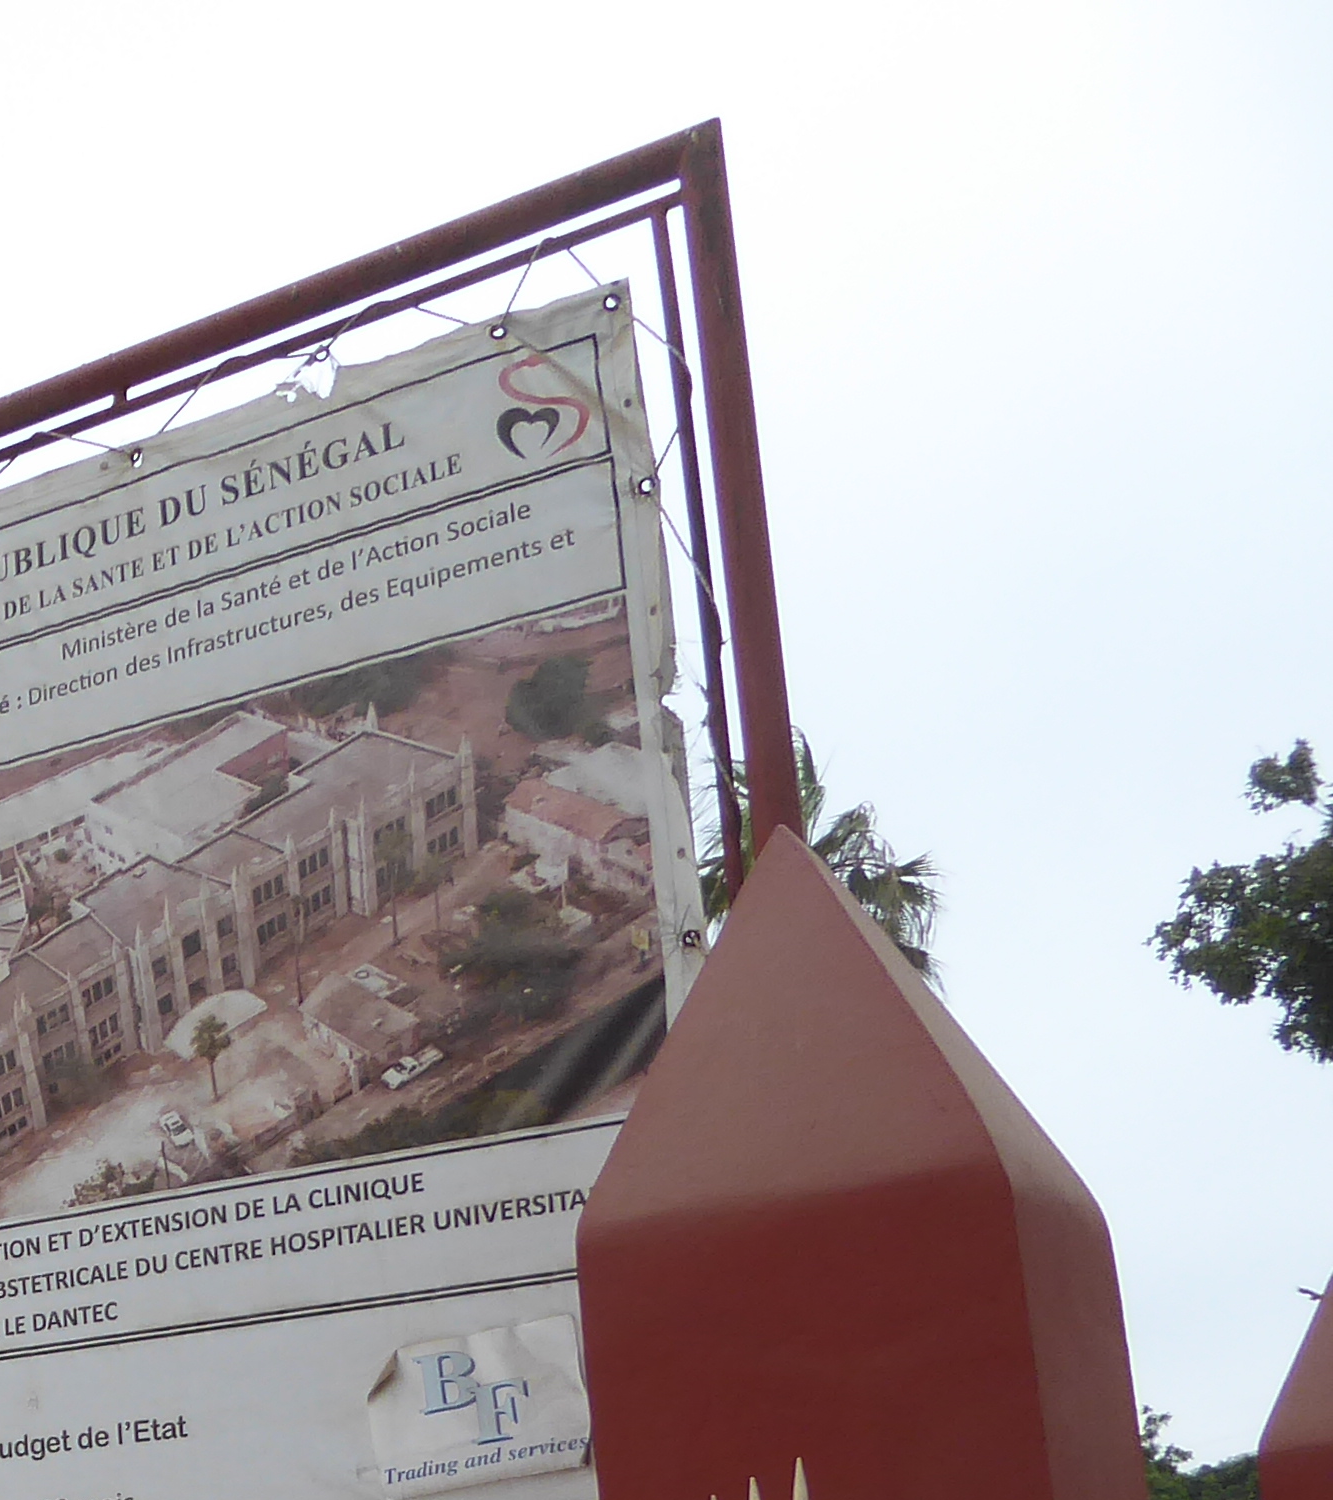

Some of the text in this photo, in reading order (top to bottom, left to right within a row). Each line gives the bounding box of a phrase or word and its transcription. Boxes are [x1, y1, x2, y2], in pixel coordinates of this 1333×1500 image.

[158, 484, 207, 528] DU
[220, 421, 406, 506] SÉNÉGAL
[3, 594, 32, 621] DE
[39, 584, 67, 609] LA
[72, 556, 145, 599] SANTE
[152, 545, 181, 572] ET
[188, 532, 219, 561] DE
[226, 491, 341, 548] L’ACTION
[349, 452, 463, 508] SOCIALE
[28, 666, 118, 706] Direction
[125, 653, 161, 677] des
[167, 603, 333, 665] Infrastructures,
[340, 587, 380, 612] des
[386, 540, 543, 599] Equipements
[550, 528, 576, 551] et
[61, 619, 158, 661] Ministère
[164, 606, 191, 629] de
[196, 599, 215, 619] la
[221, 574, 282, 612] Santé
[288, 568, 311, 590] et
[317, 558, 345, 581] de
[351, 531, 440, 571] l’Action
[446, 501, 531, 542] Sociale
[47, 1230, 73, 1253] ET
[78, 1204, 228, 1248] D’EXTENSION
[234, 1197, 266, 1222] DE
[272, 1192, 303, 1216] LA
[307, 1171, 425, 1210] CLINIQUE
[134, 1253, 168, 1278] DU
[174, 1238, 264, 1271] CENTRE
[270, 1213, 427, 1257] HOSPITALIER
[4, 1315, 27, 1337] LE
[32, 1301, 119, 1333] DANTEC
[77, 1425, 110, 1450] de
[117, 1414, 189, 1446] l’Etat
[383, 1435, 590, 1486] Trading and services
